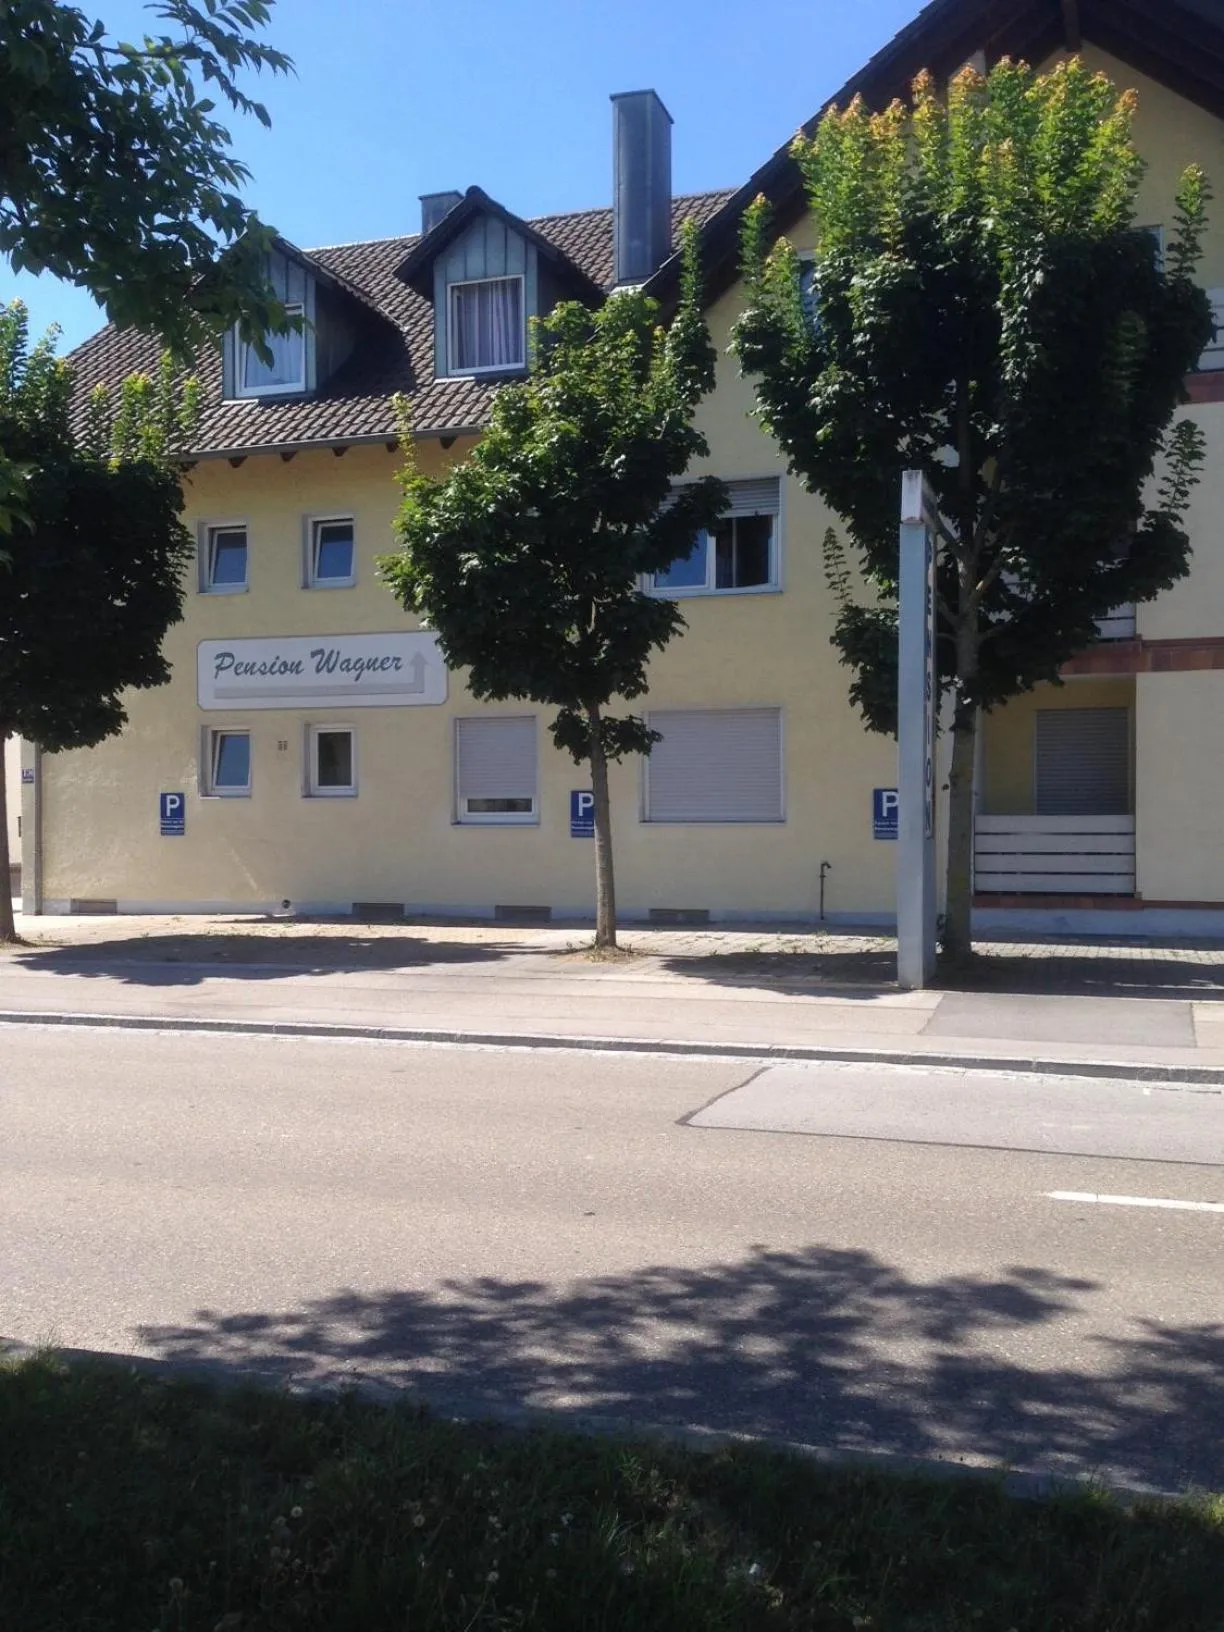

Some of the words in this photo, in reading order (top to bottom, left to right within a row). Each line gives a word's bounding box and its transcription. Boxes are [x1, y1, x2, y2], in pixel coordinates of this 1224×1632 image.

[214, 652, 304, 679] Pension
[310, 648, 402, 681] Wagner
[166, 795, 180, 817] P
[578, 792, 595, 817] P
[882, 791, 899, 817] P
